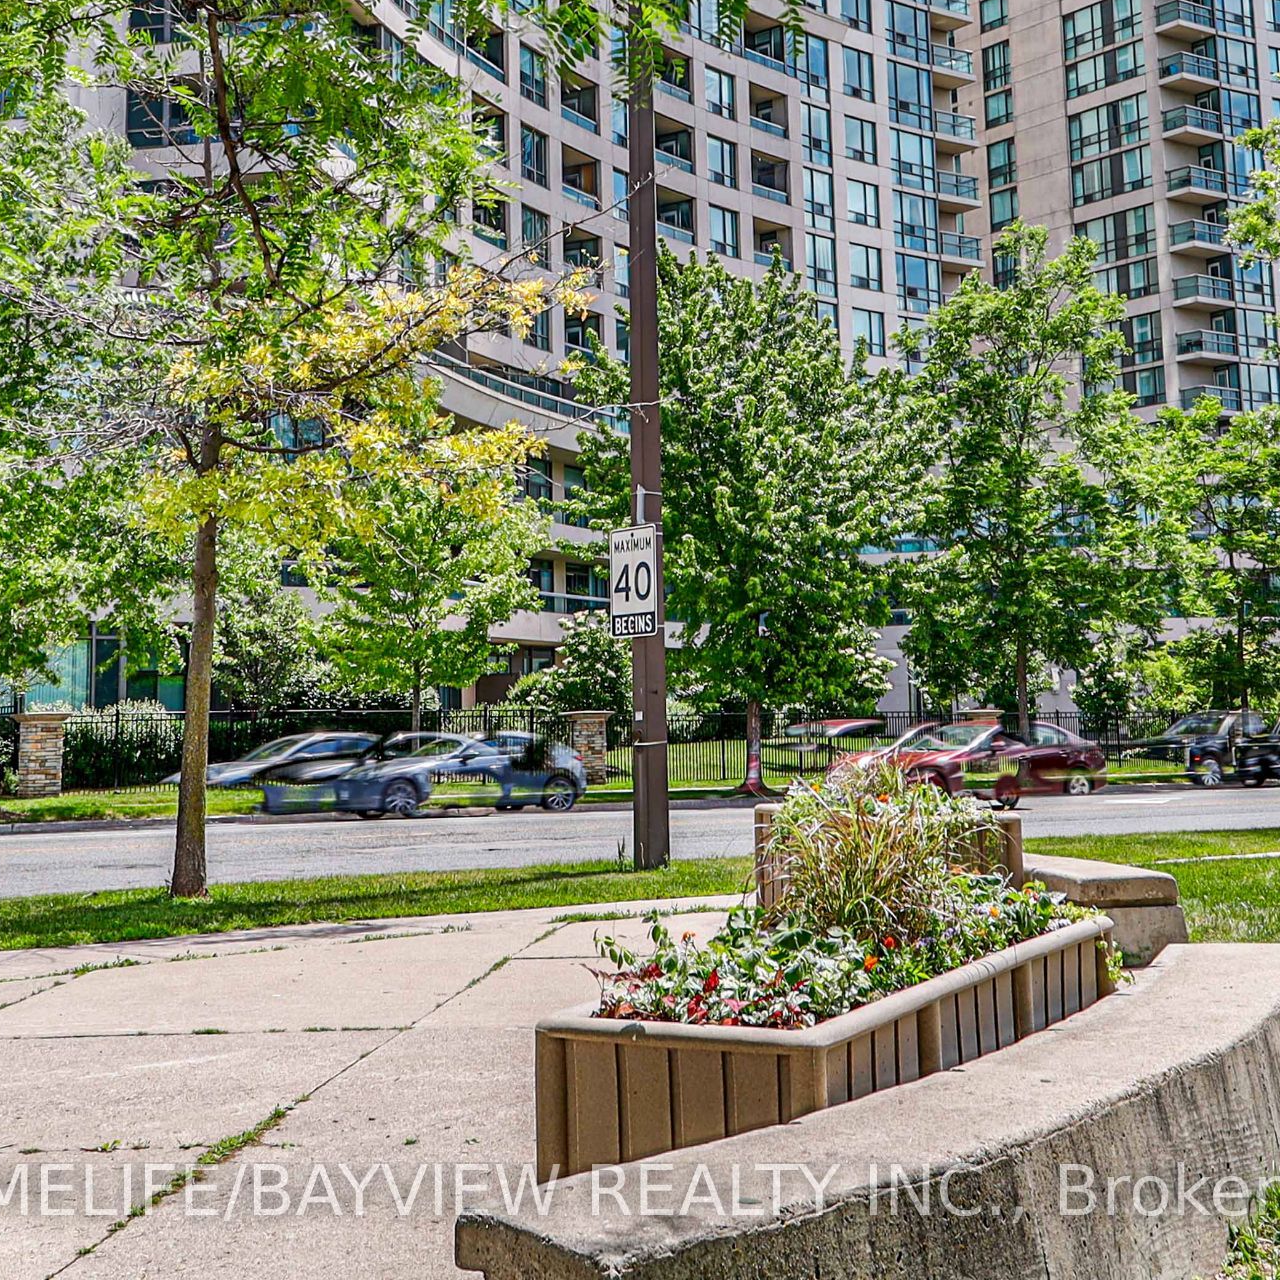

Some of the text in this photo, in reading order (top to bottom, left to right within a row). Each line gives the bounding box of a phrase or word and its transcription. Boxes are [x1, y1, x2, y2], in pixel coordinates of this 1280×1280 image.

[614, 537, 651, 553] MAXIMUM
[614, 561, 652, 602] 40
[614, 615, 652, 634] BEGINS
